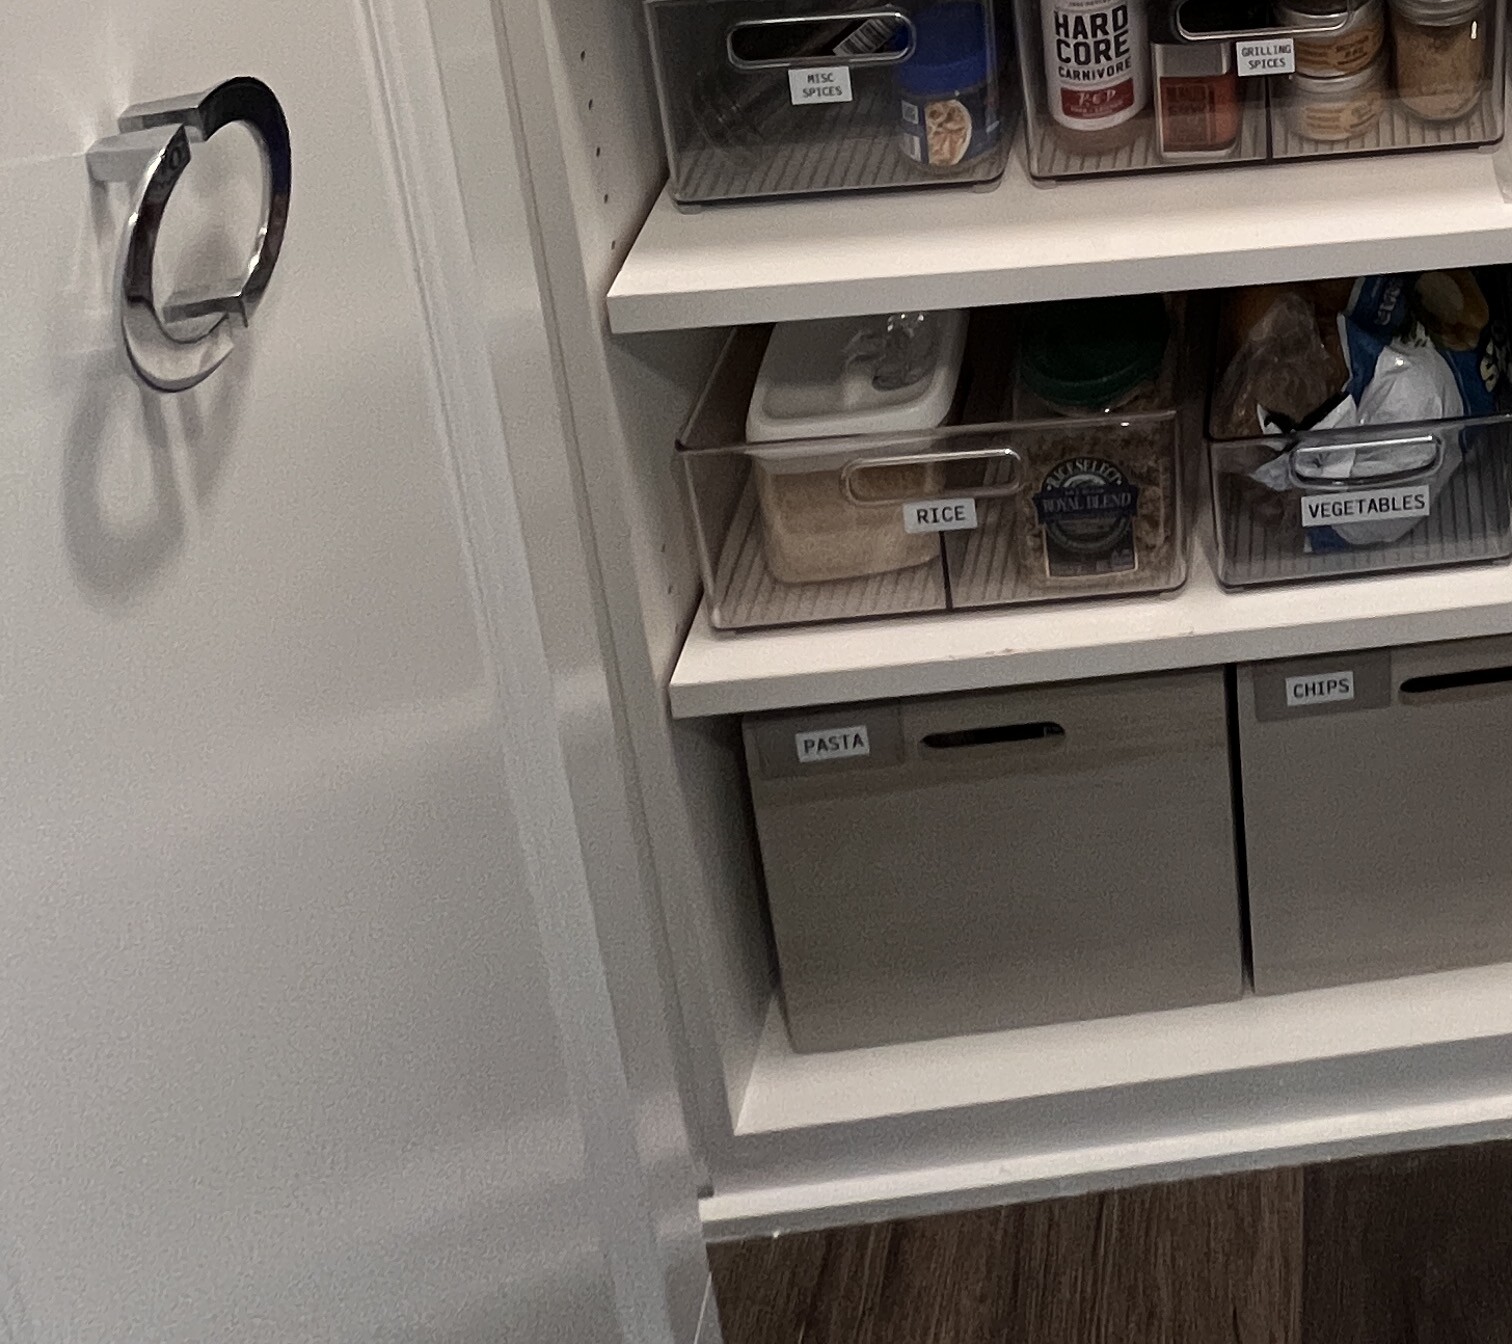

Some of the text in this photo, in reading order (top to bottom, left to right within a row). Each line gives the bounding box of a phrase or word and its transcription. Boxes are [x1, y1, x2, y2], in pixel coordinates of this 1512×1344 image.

[1054, 5, 1128, 40] HARD
[1056, 30, 1130, 65] CORE
[1241, 43, 1291, 57] GRILLING
[1058, 56, 1131, 81] CARNIVORE
[1248, 57, 1286, 69] SPICES
[807, 73, 834, 84] MISC
[802, 85, 843, 98] SPICES
[916, 506, 966, 524] RICE
[1308, 494, 1425, 519] VEGETABLES
[1293, 675, 1350, 699] CHIPS
[803, 733, 865, 754] PASTA
